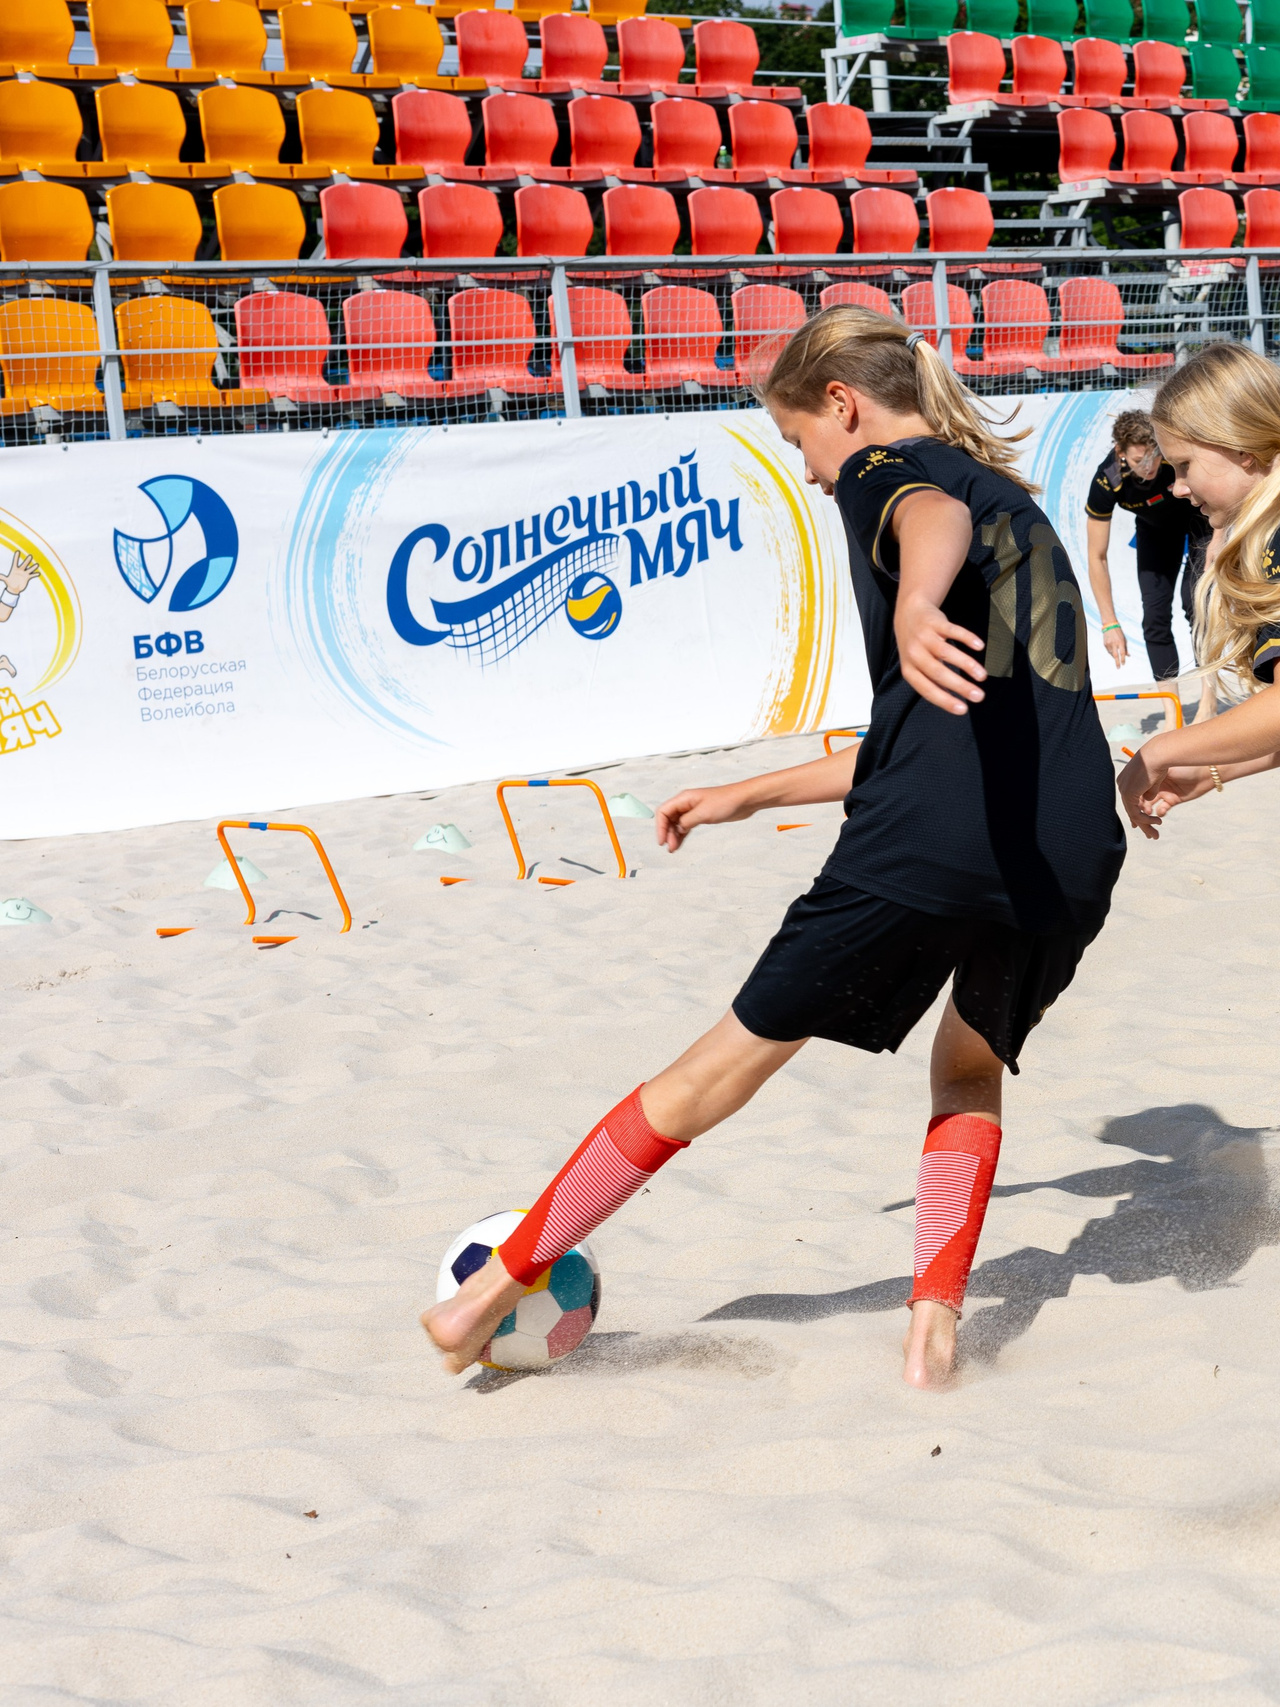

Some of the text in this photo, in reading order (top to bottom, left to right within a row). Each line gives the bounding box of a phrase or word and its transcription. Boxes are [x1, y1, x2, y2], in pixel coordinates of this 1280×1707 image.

[857, 457, 905, 479] KELME
[386, 447, 704, 647] Солнечный
[981, 511, 1089, 693] 16
[133, 629, 205, 660] БФВ
[136, 659, 247, 682] Белорусская
[138, 681, 234, 701] Федерация
[140, 701, 236, 722] Волейбола
